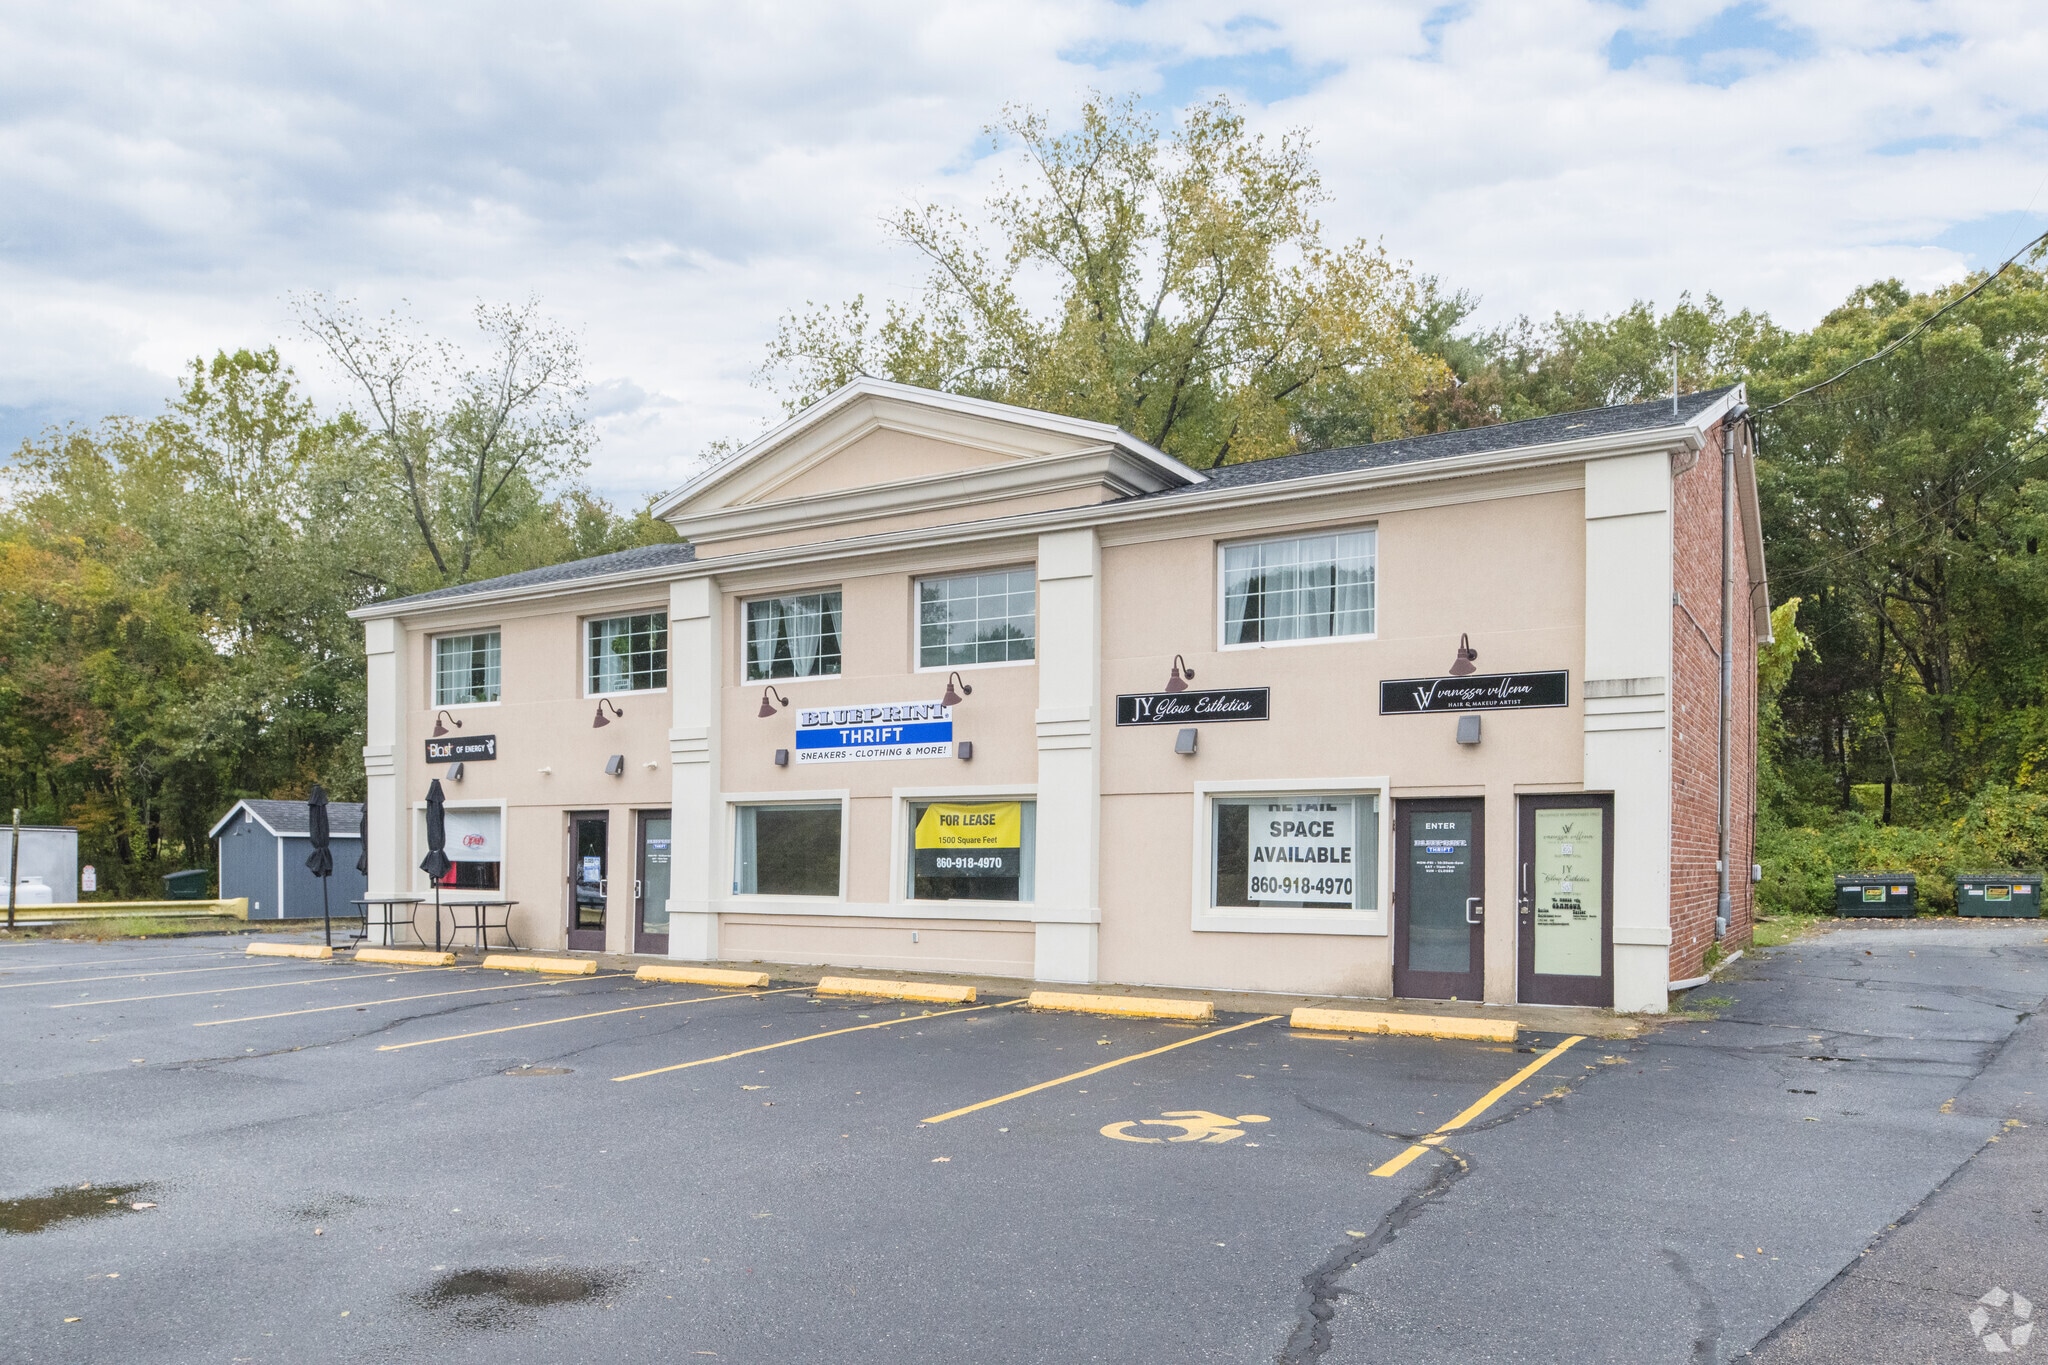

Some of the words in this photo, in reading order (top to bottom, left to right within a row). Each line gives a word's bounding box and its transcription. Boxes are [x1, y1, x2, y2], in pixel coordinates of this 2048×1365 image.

[801, 703, 947, 727] BLUEPRINT
[1132, 697, 1154, 722] JY
[1153, 698, 1191, 721] Glow
[1195, 696, 1252, 714] Esthetics
[839, 727, 904, 745] THRIFT
[456, 746, 464, 754] OF
[465, 744, 486, 753] ENERGY
[801, 750, 847, 761] SNEAKERS
[855, 747, 902, 758] CLOTHING
[906, 747, 912, 756] &
[915, 746, 947, 755] MORE!
[939, 814, 960, 827] FOR
[963, 813, 996, 826] LEASE
[1425, 822, 1456, 830] ENTER
[1269, 820, 1335, 838] SPACE
[938, 836, 956, 844] 1500
[957, 836, 982, 845] Square
[983, 835, 998, 844] Feet
[1253, 846, 1352, 863] AVAILABLE
[936, 857, 1002, 869] 860-918-4970
[1251, 876, 1353, 895] 860-918-4970
